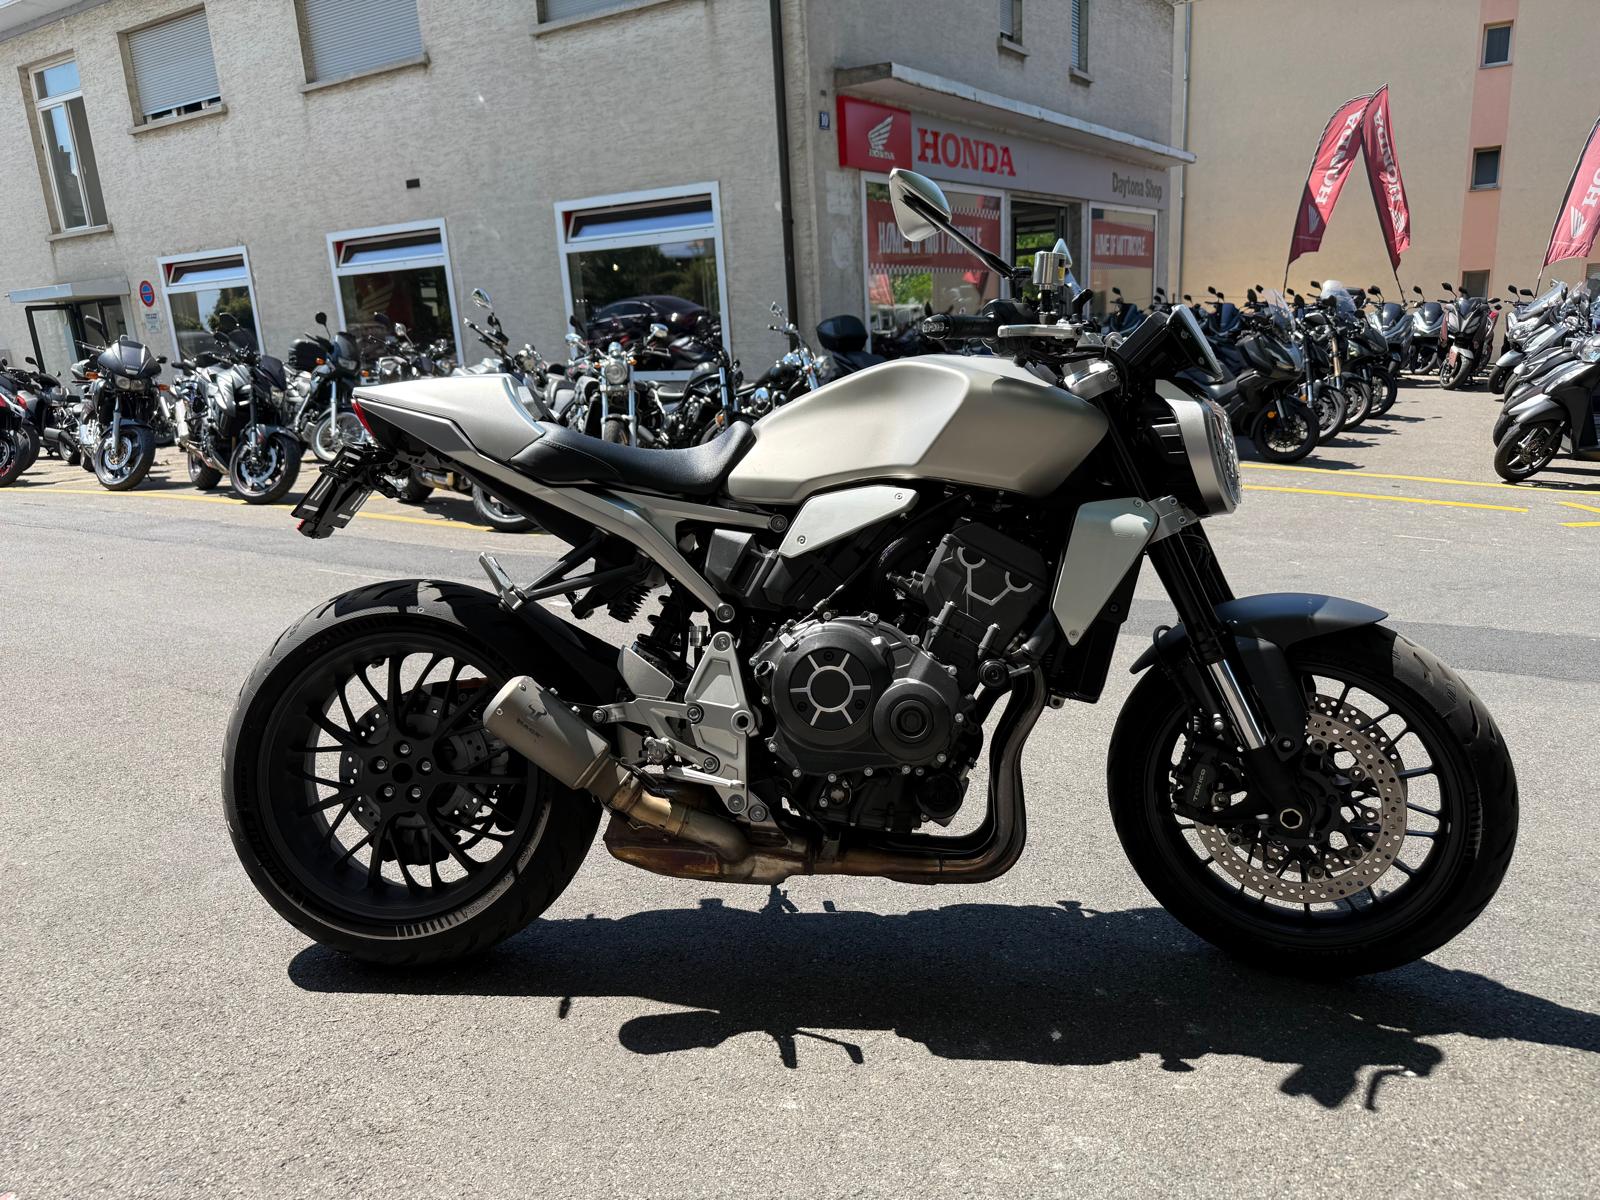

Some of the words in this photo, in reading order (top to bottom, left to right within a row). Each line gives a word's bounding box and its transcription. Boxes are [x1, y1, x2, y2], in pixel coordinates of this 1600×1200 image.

[917, 127, 1017, 177] HONDA
[1112, 171, 1144, 198] Daytona
[1145, 178, 1162, 203] Shop
